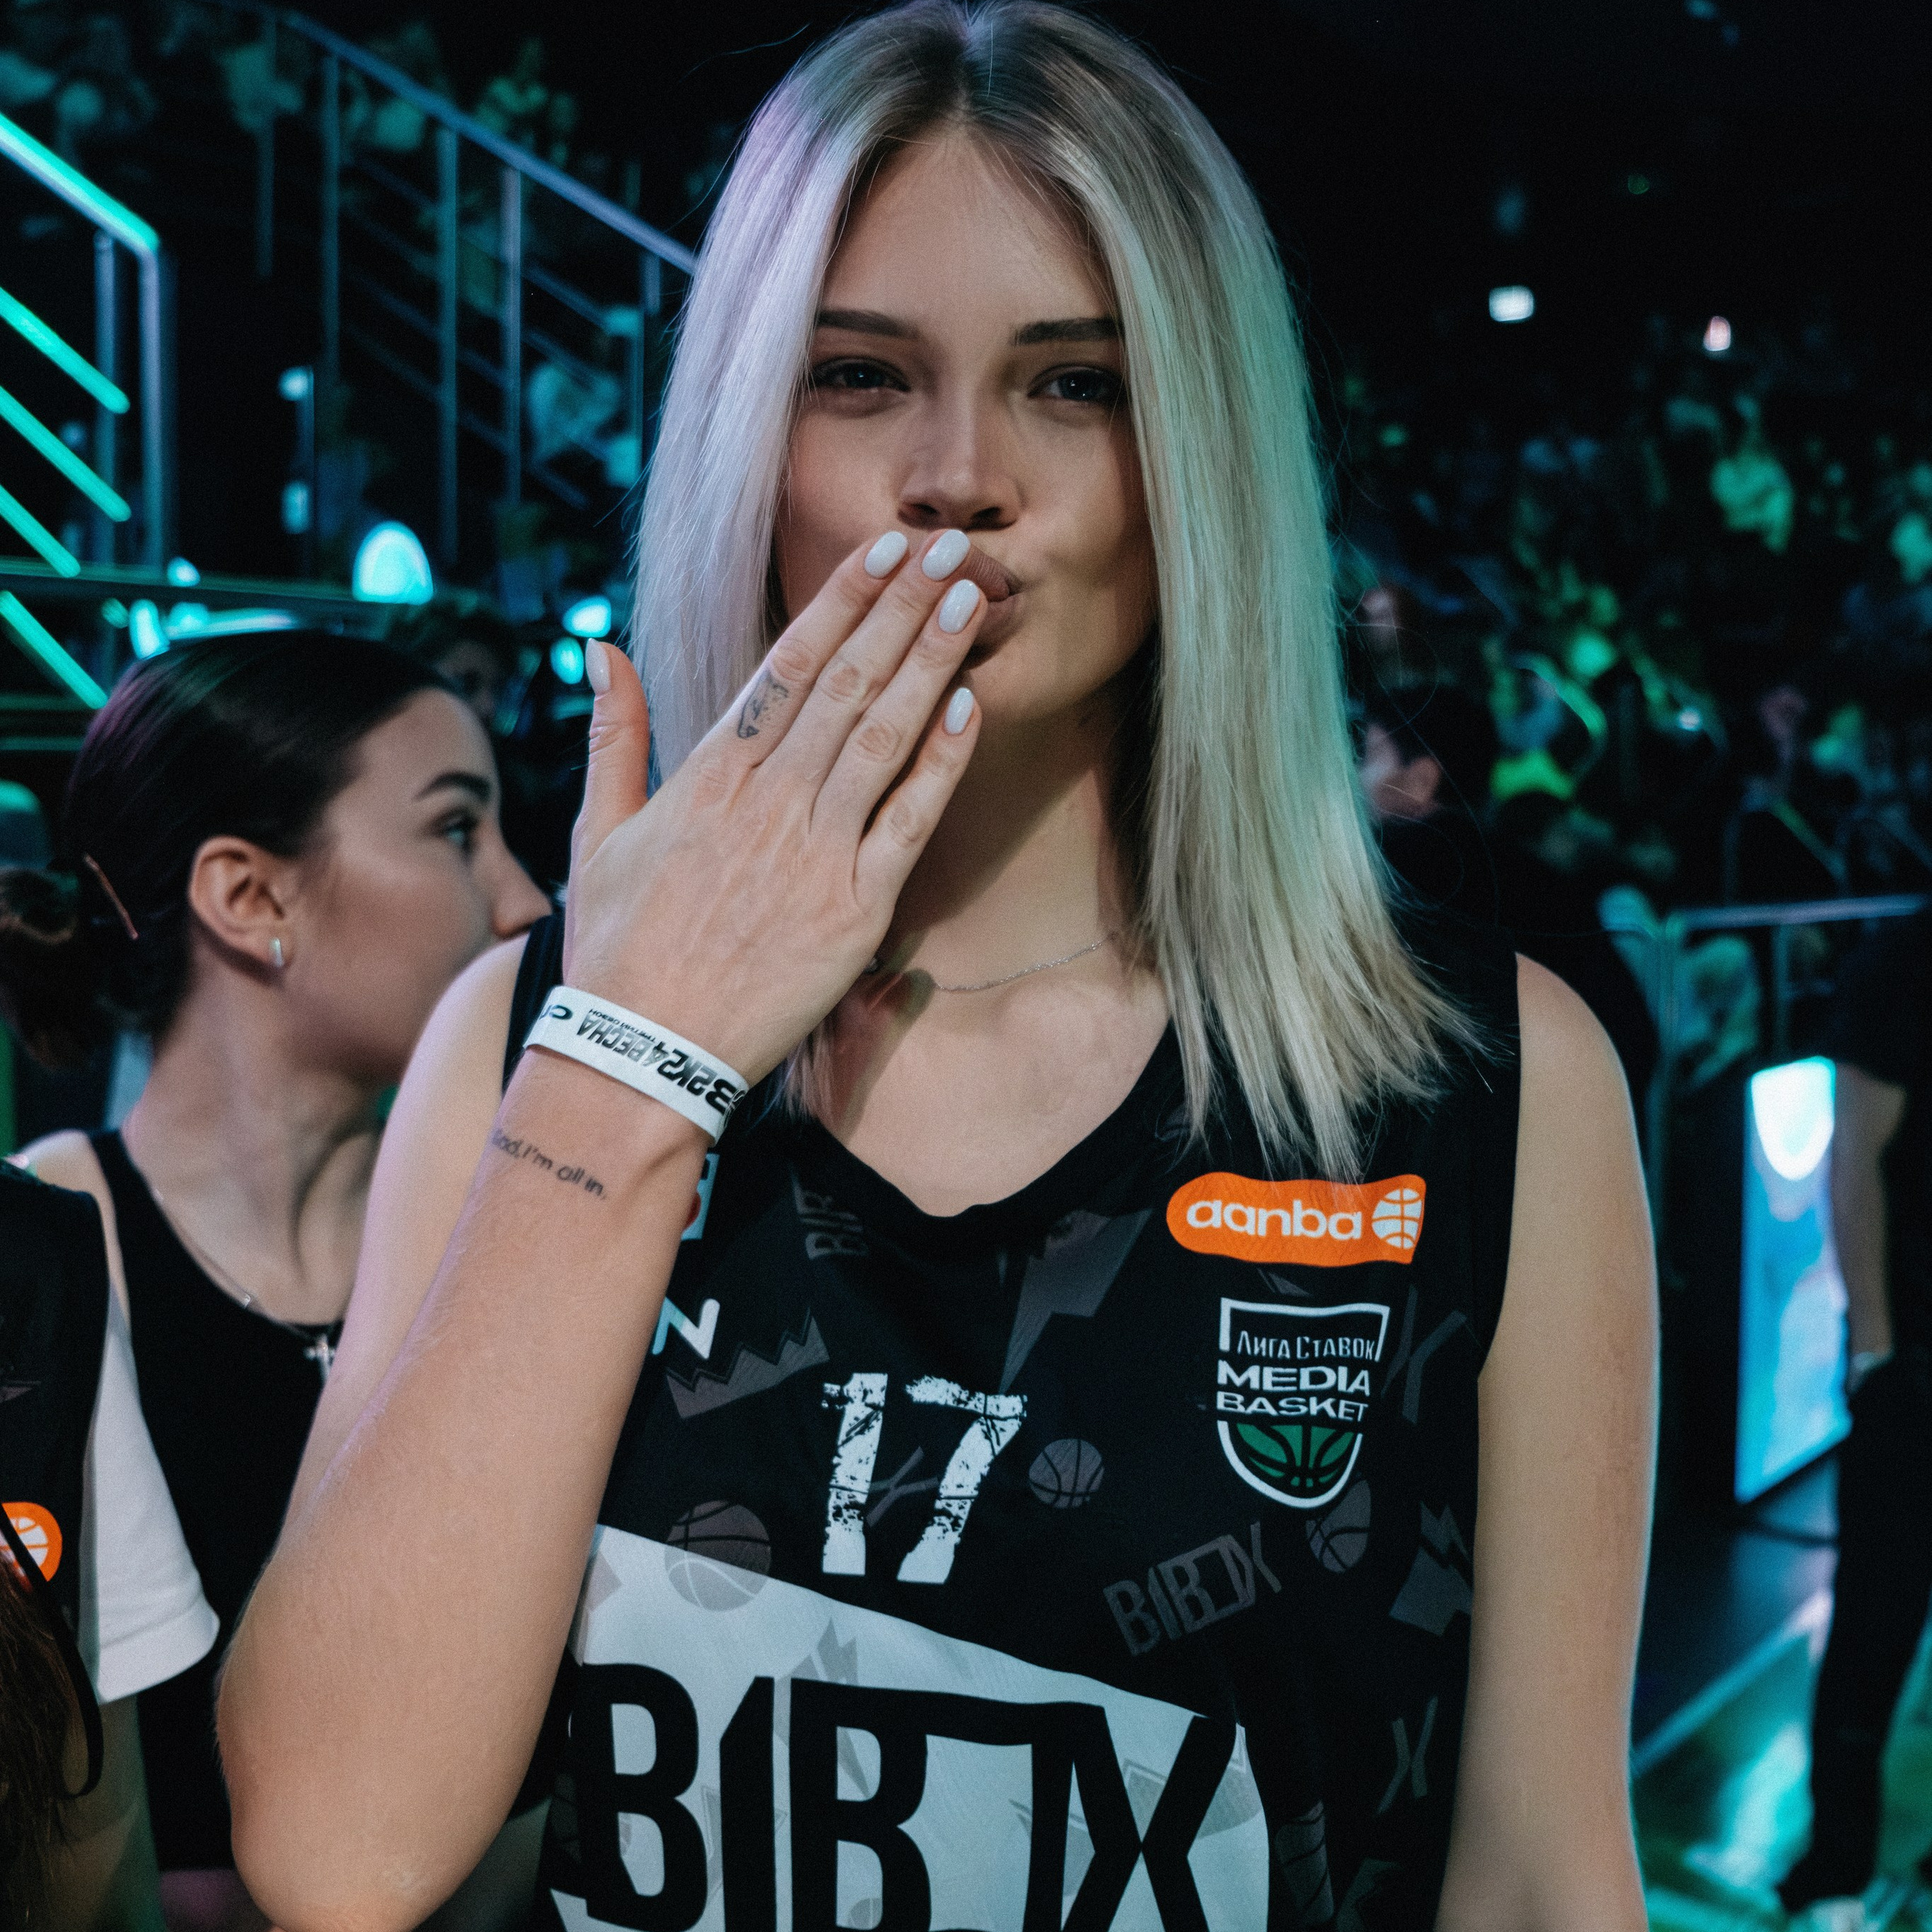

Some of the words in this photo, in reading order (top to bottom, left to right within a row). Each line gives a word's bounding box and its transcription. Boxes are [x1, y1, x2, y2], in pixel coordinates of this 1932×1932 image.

[558, 1164, 585, 1184] all
[1186, 1199, 1362, 1240] aanba
[1217, 1360, 1370, 1396] MEDIA
[1216, 1390, 1368, 1422] BASKET
[821, 1372, 1028, 1585] 17
